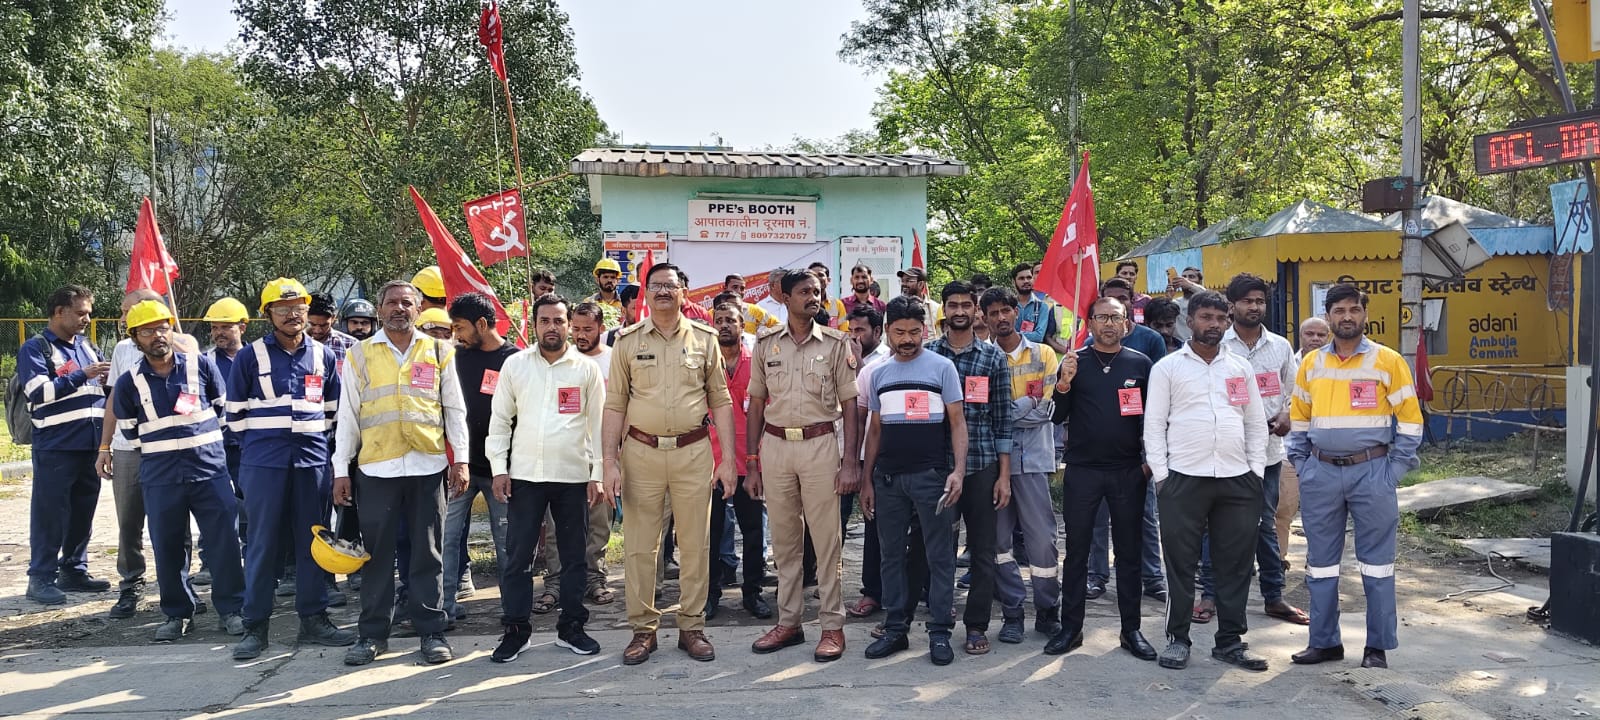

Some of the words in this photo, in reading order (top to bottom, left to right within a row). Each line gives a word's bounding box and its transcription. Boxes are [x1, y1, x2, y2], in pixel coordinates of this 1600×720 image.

[708, 203, 745, 214] PPE's
[748, 204, 795, 215] BOOTH
[694, 215, 759, 228] आपातकालीन
[750, 231, 807, 240] 8097327057
[1469, 312, 1518, 333] adani
[1470, 335, 1517, 348] Ambuja
[1469, 347, 1519, 359] Cement
